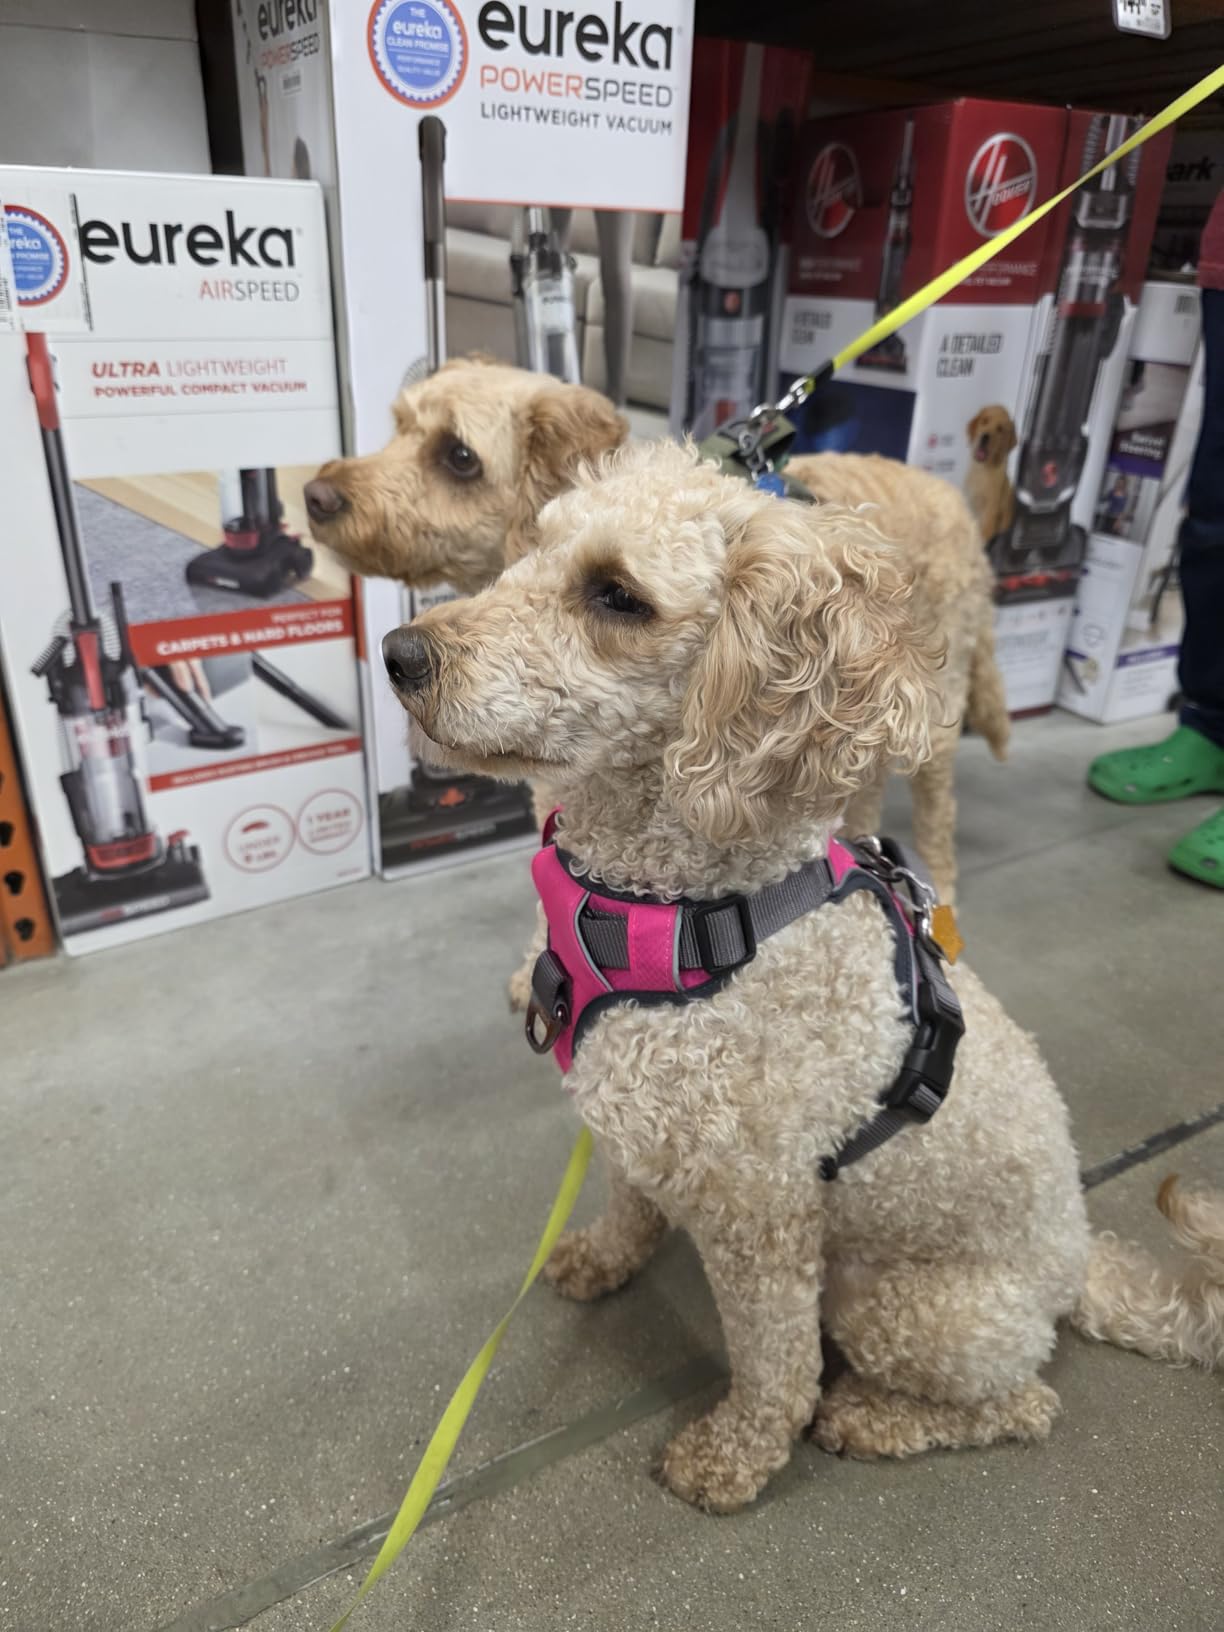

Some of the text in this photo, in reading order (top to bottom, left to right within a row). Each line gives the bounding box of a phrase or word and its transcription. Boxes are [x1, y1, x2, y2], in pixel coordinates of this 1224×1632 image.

[393, 20, 442, 39] eureka
[478, 0, 673, 70] eureka
[480, 65, 673, 108] POWERSPEED
[481, 102, 673, 136] LIGHTWEIGHT VACUUM
[1167, 156, 1216, 182] ark
[11, 236, 42, 250] reka
[80, 210, 295, 268] eureka
[200, 280, 300, 302] AIRSPEED
[951, 332, 1004, 353] DETAILED
[92, 358, 288, 378] ULTRA LIGHTWEIGHT
[936, 358, 975, 378] CLEAN
[93, 380, 308, 398] POWERFUL COMPACT VACUUM
[157, 619, 344, 656] CARPETS & HARD FLOORS
